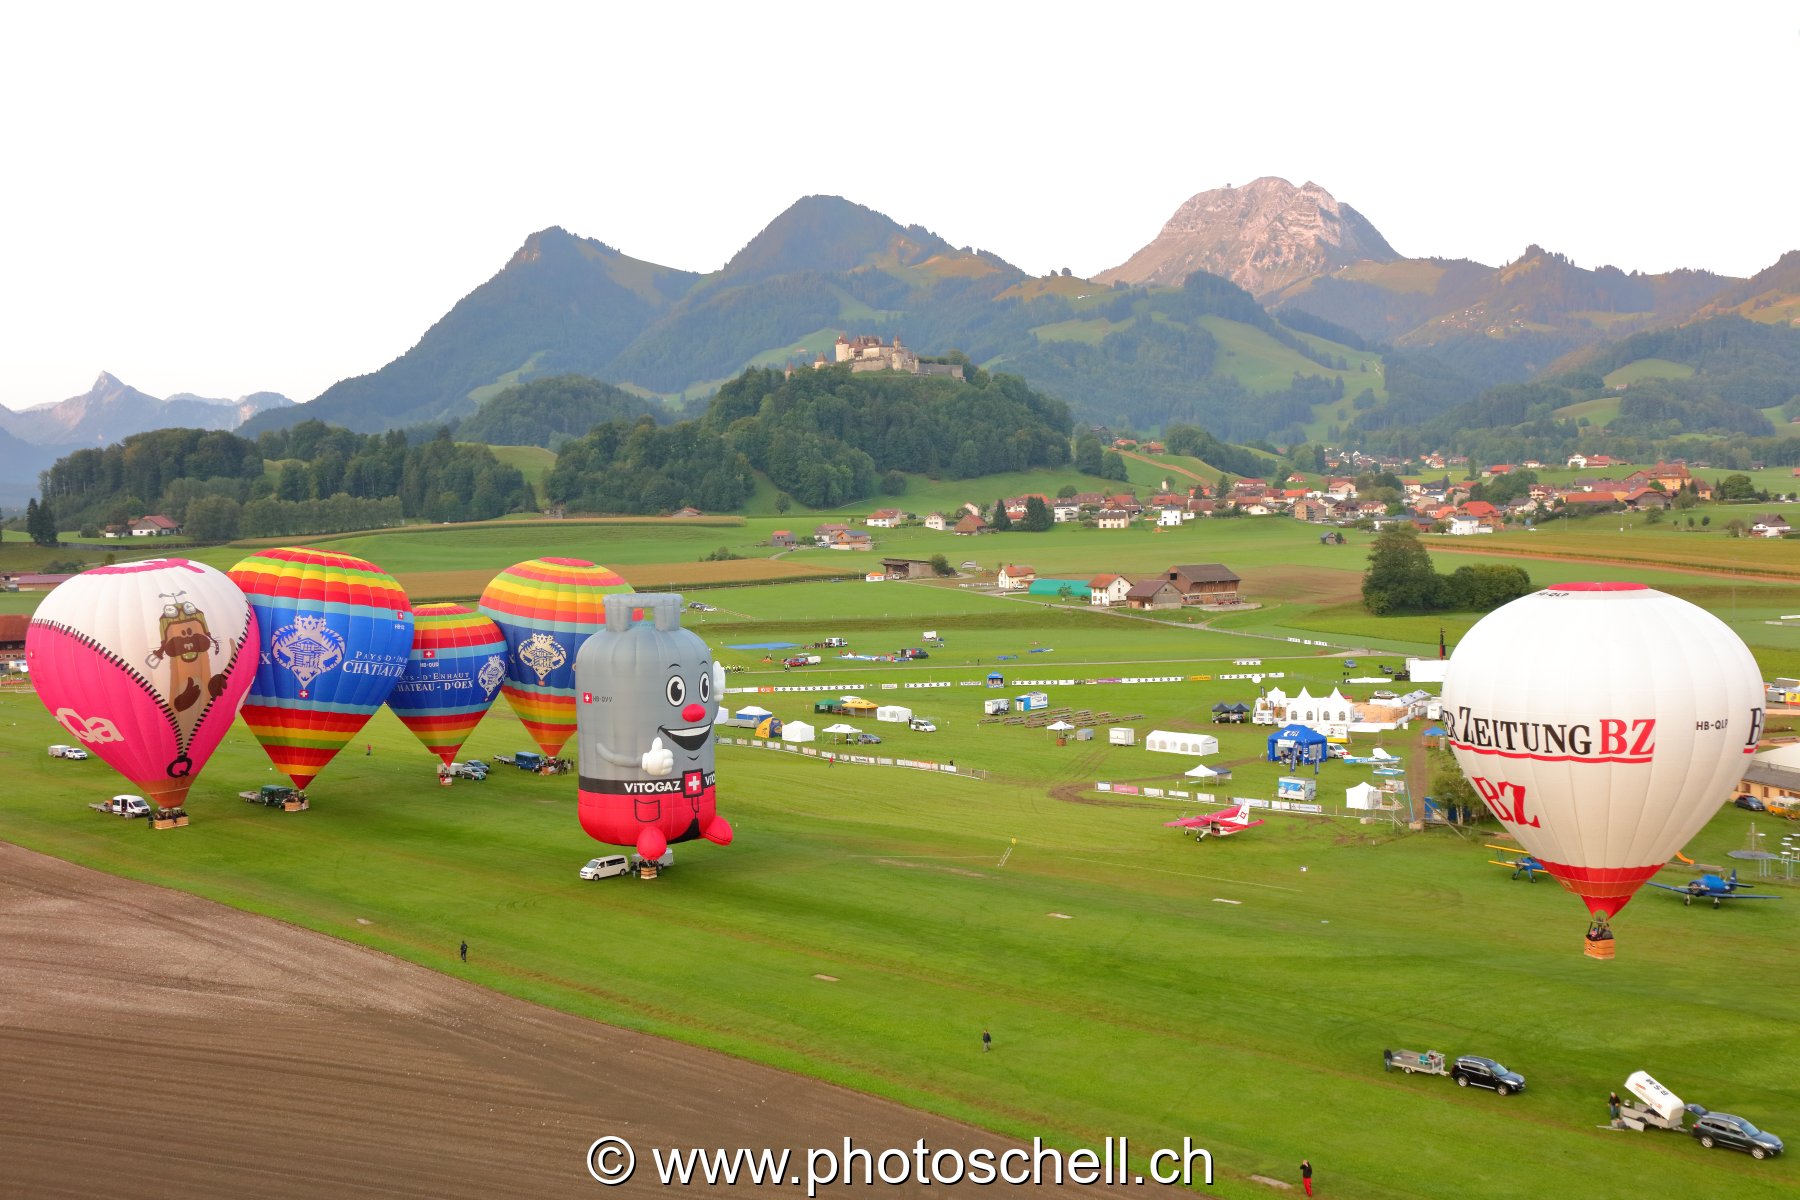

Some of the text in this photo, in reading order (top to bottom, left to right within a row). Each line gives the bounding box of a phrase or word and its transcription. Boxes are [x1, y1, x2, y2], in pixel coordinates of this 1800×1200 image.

[396, 683, 435, 692] HATEAU
[444, 680, 474, 691] D'OEX
[1458, 706, 1592, 755] ZEITUNG
[1599, 719, 1656, 755] BZ
[1696, 719, 1728, 730] HB-QLP
[1472, 776, 1541, 828] BZ
